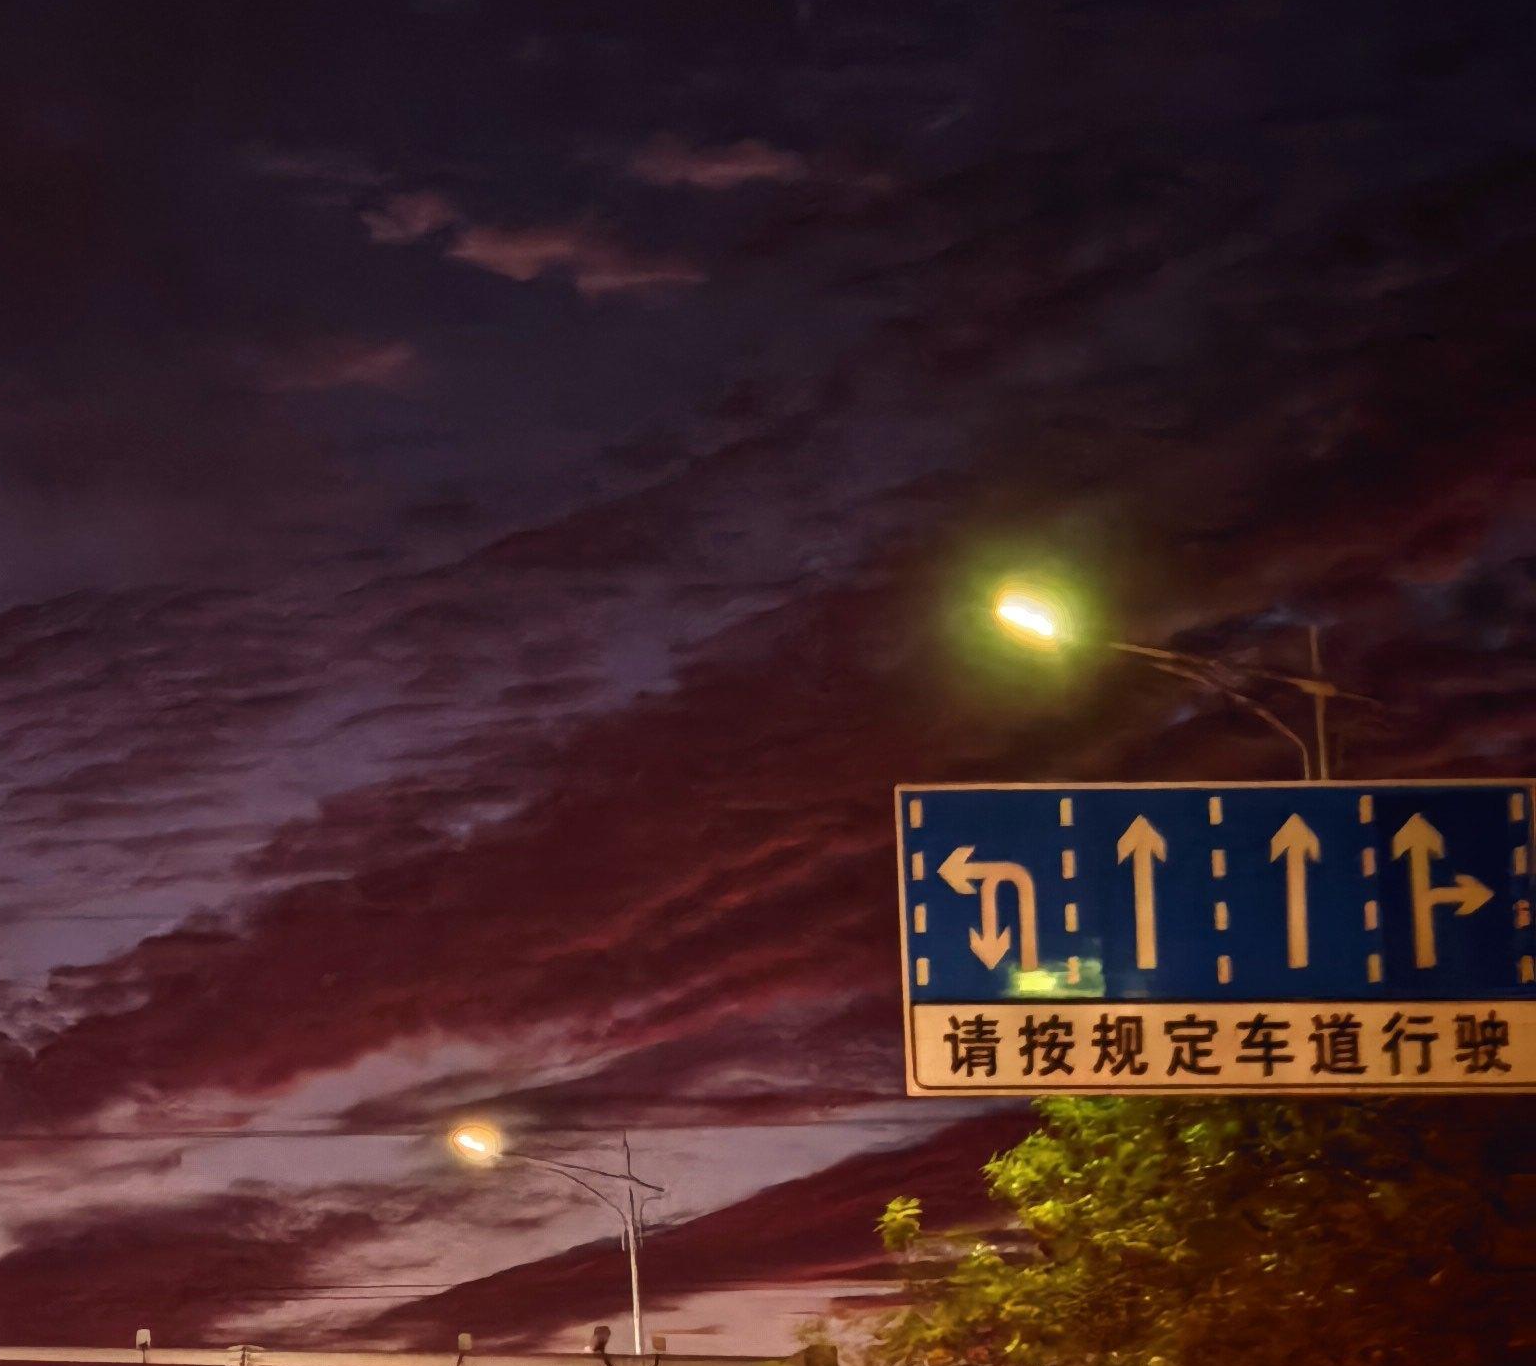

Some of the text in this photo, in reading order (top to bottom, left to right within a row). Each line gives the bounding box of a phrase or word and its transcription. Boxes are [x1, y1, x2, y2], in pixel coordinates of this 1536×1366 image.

[943, 1010, 1513, 1078] 请按规定车道行驶
